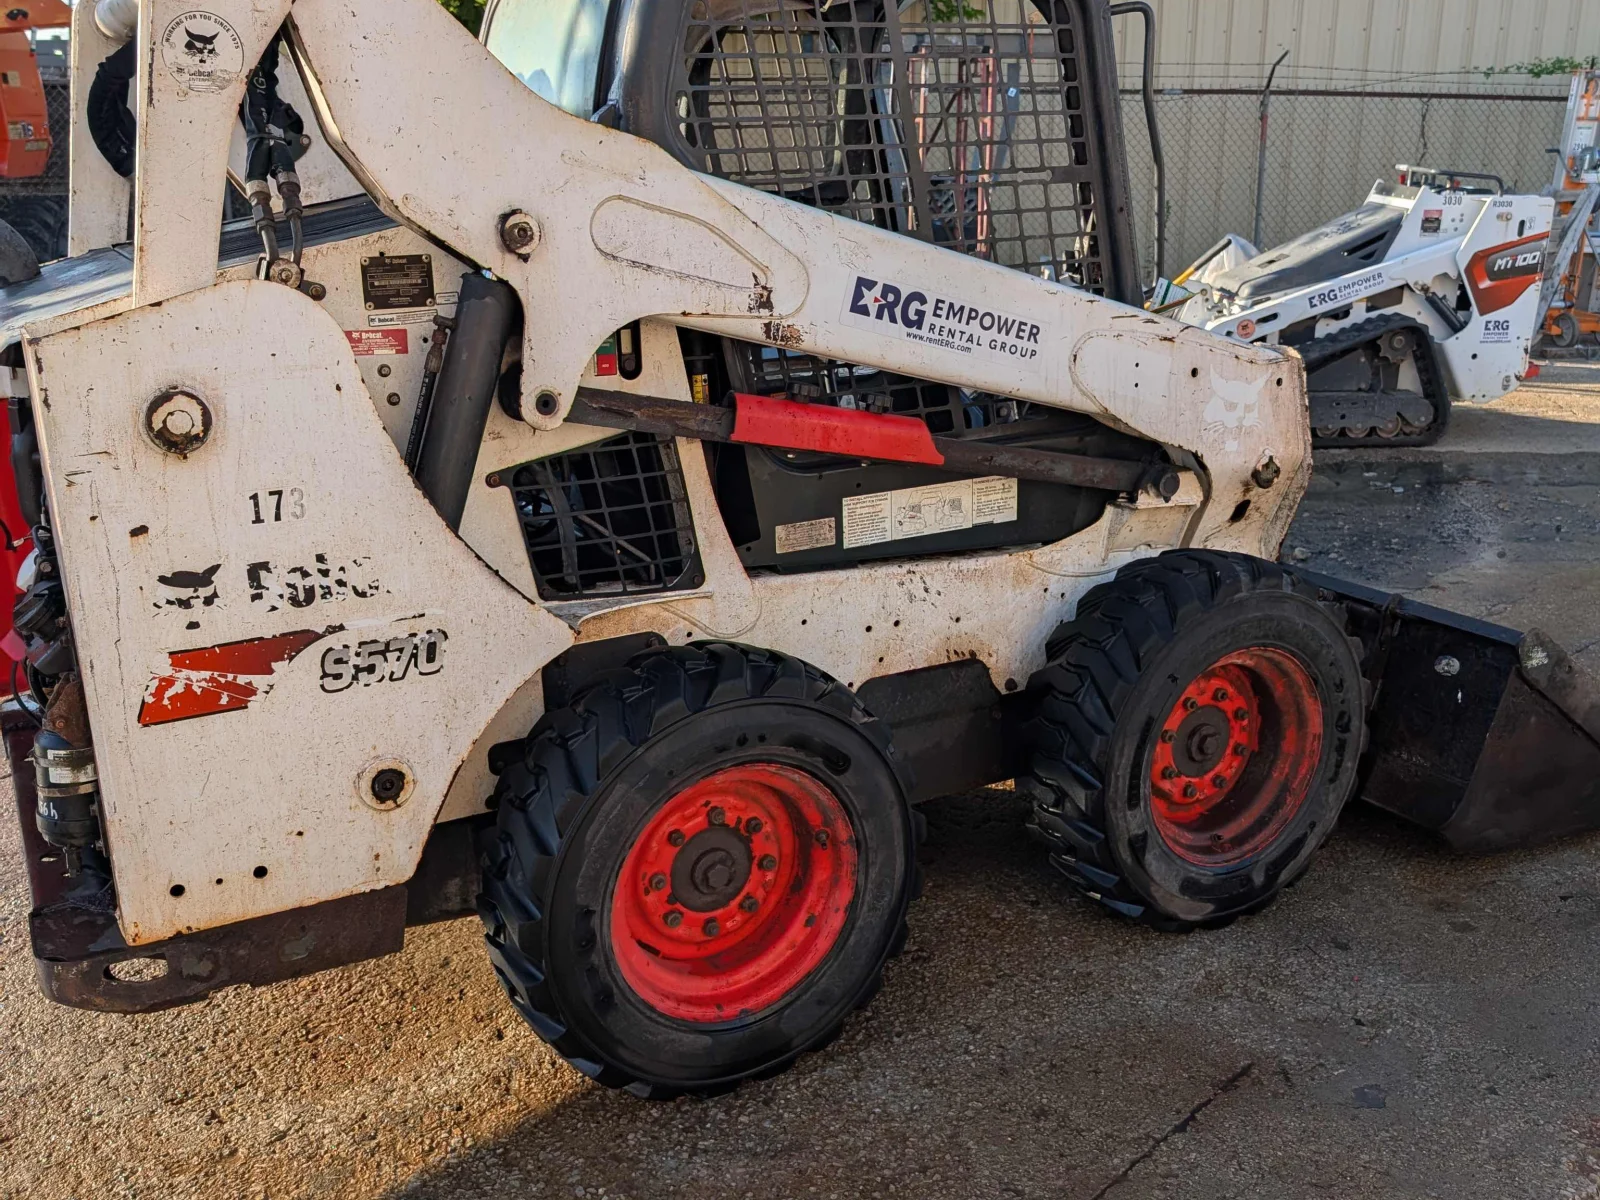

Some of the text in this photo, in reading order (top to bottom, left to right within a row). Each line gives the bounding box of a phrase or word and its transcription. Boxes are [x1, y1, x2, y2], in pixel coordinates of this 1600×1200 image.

[165, 19, 184, 42] WORKING
[214, 18, 231, 33] SINCE
[1442, 196, 1462, 206] 3030
[1494, 251, 1541, 271] MT100
[1337, 272, 1383, 293] EMPOWER
[849, 276, 928, 331] ERG
[1308, 289, 1338, 309] ERG
[932, 298, 1041, 344] EMPOWER
[1484, 320, 1510, 331] ERG
[906, 331, 972, 354] www.rentERG.com
[928, 323, 1037, 360] RENTAL GROUP
[248, 487, 307, 525] 173
[319, 628, 449, 694] S570
